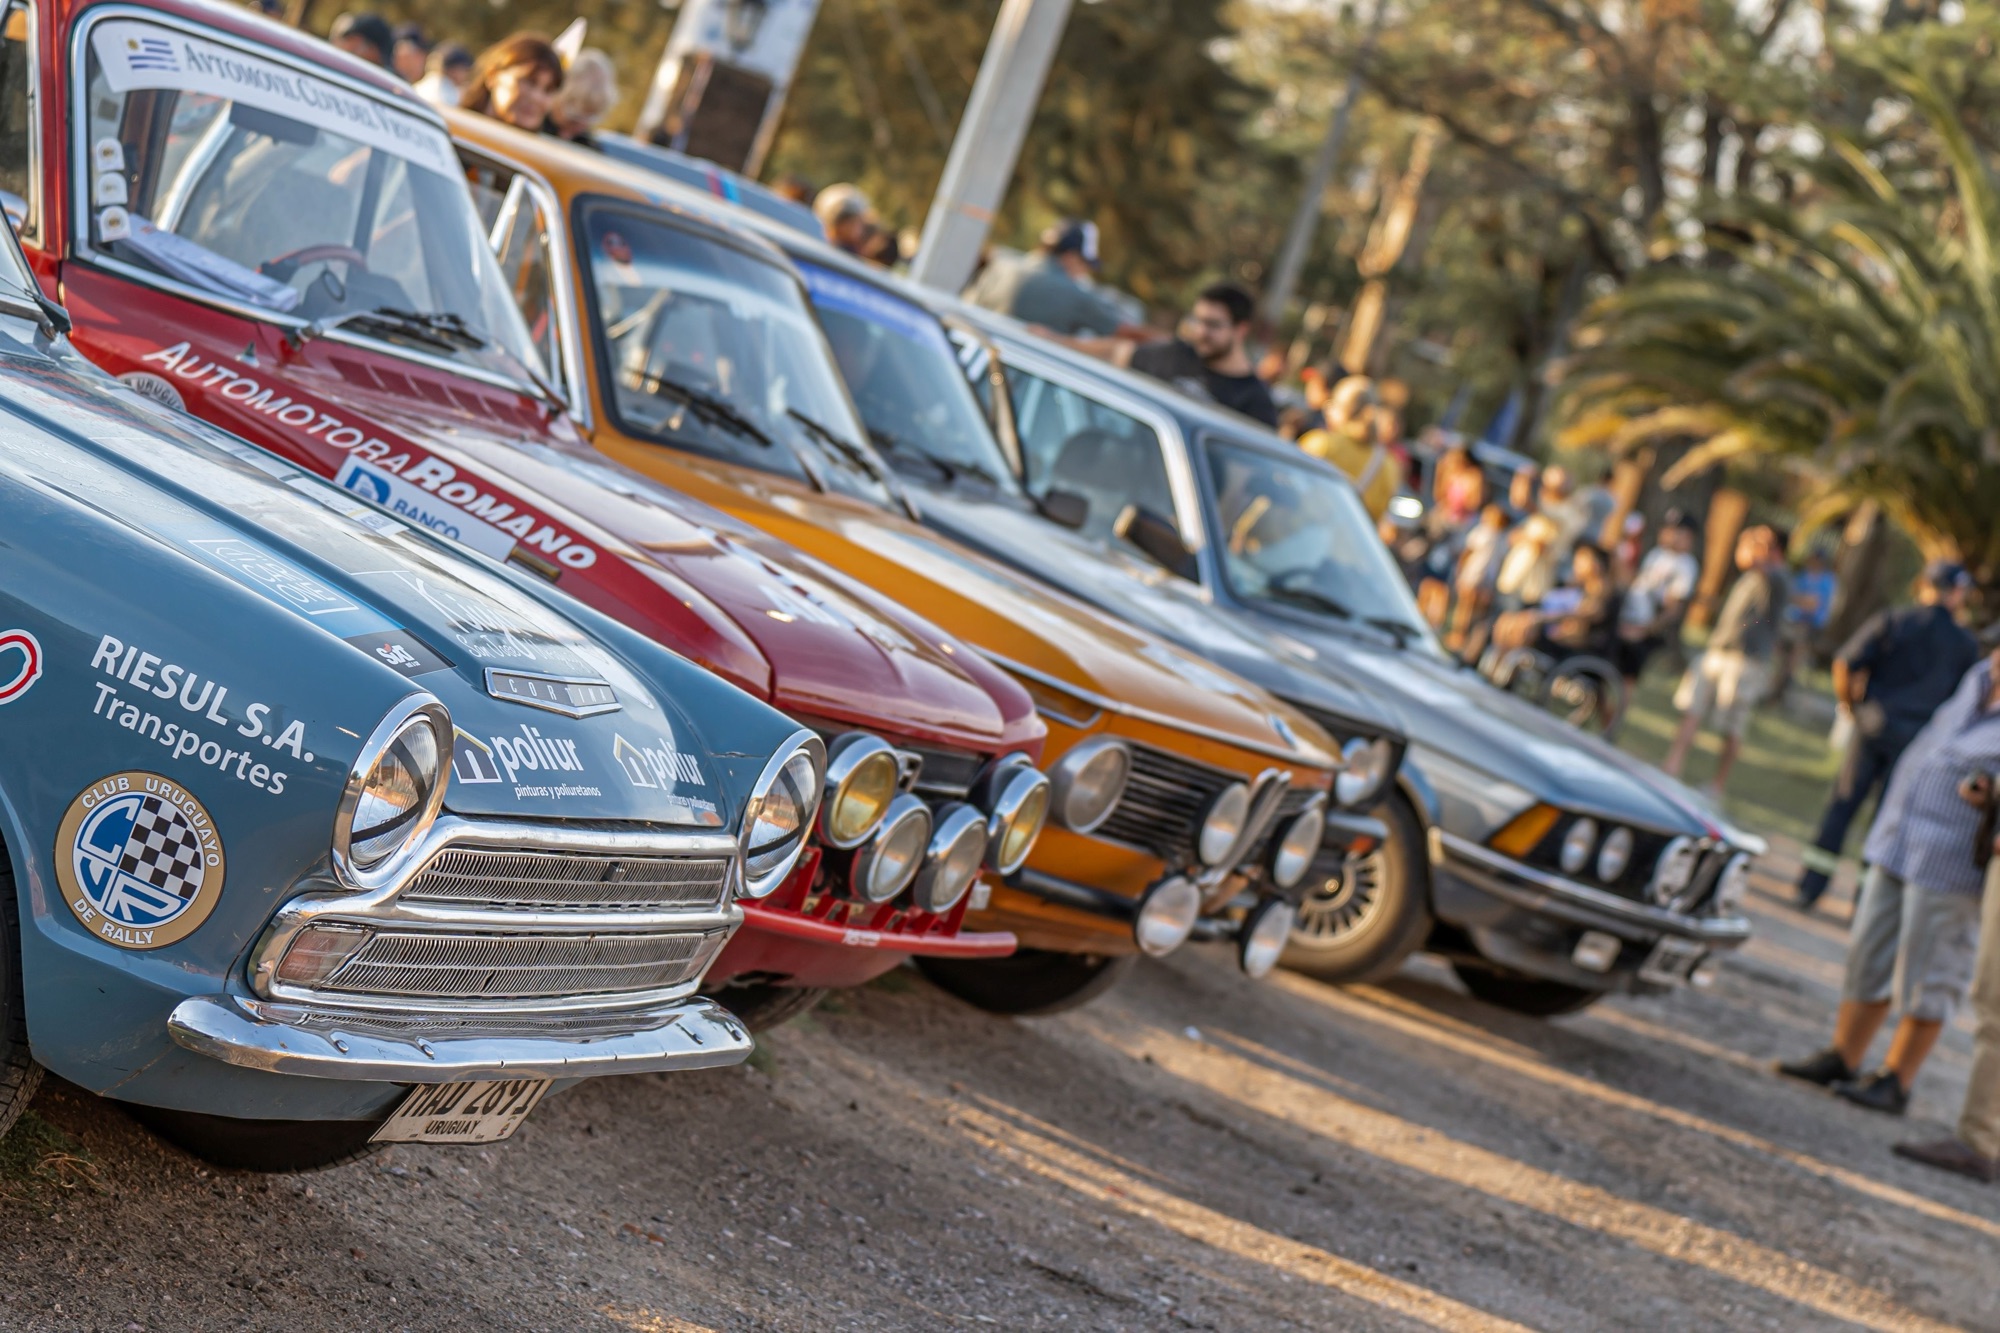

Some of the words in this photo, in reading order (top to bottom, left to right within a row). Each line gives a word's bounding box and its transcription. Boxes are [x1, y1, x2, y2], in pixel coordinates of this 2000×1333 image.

[142, 341, 411, 474] AUTOMOTORA
[401, 456, 597, 569] ROMANO
[90, 634, 228, 726] RIESUL
[236, 702, 314, 763] S.A.
[508, 678, 607, 704] CORTINA
[92, 682, 288, 795] Transportes
[490, 723, 584, 783] poliur
[642, 737, 706, 790] poliur
[516, 785, 549, 800] pinturas
[554, 784, 602, 800] poliuretanos
[81, 776, 130, 809] CLUB
[145, 777, 220, 867] URUGUAYO
[73, 897, 97, 923] DE
[101, 922, 155, 944] RALLY
[425, 1120, 481, 1136] URUGUAY
